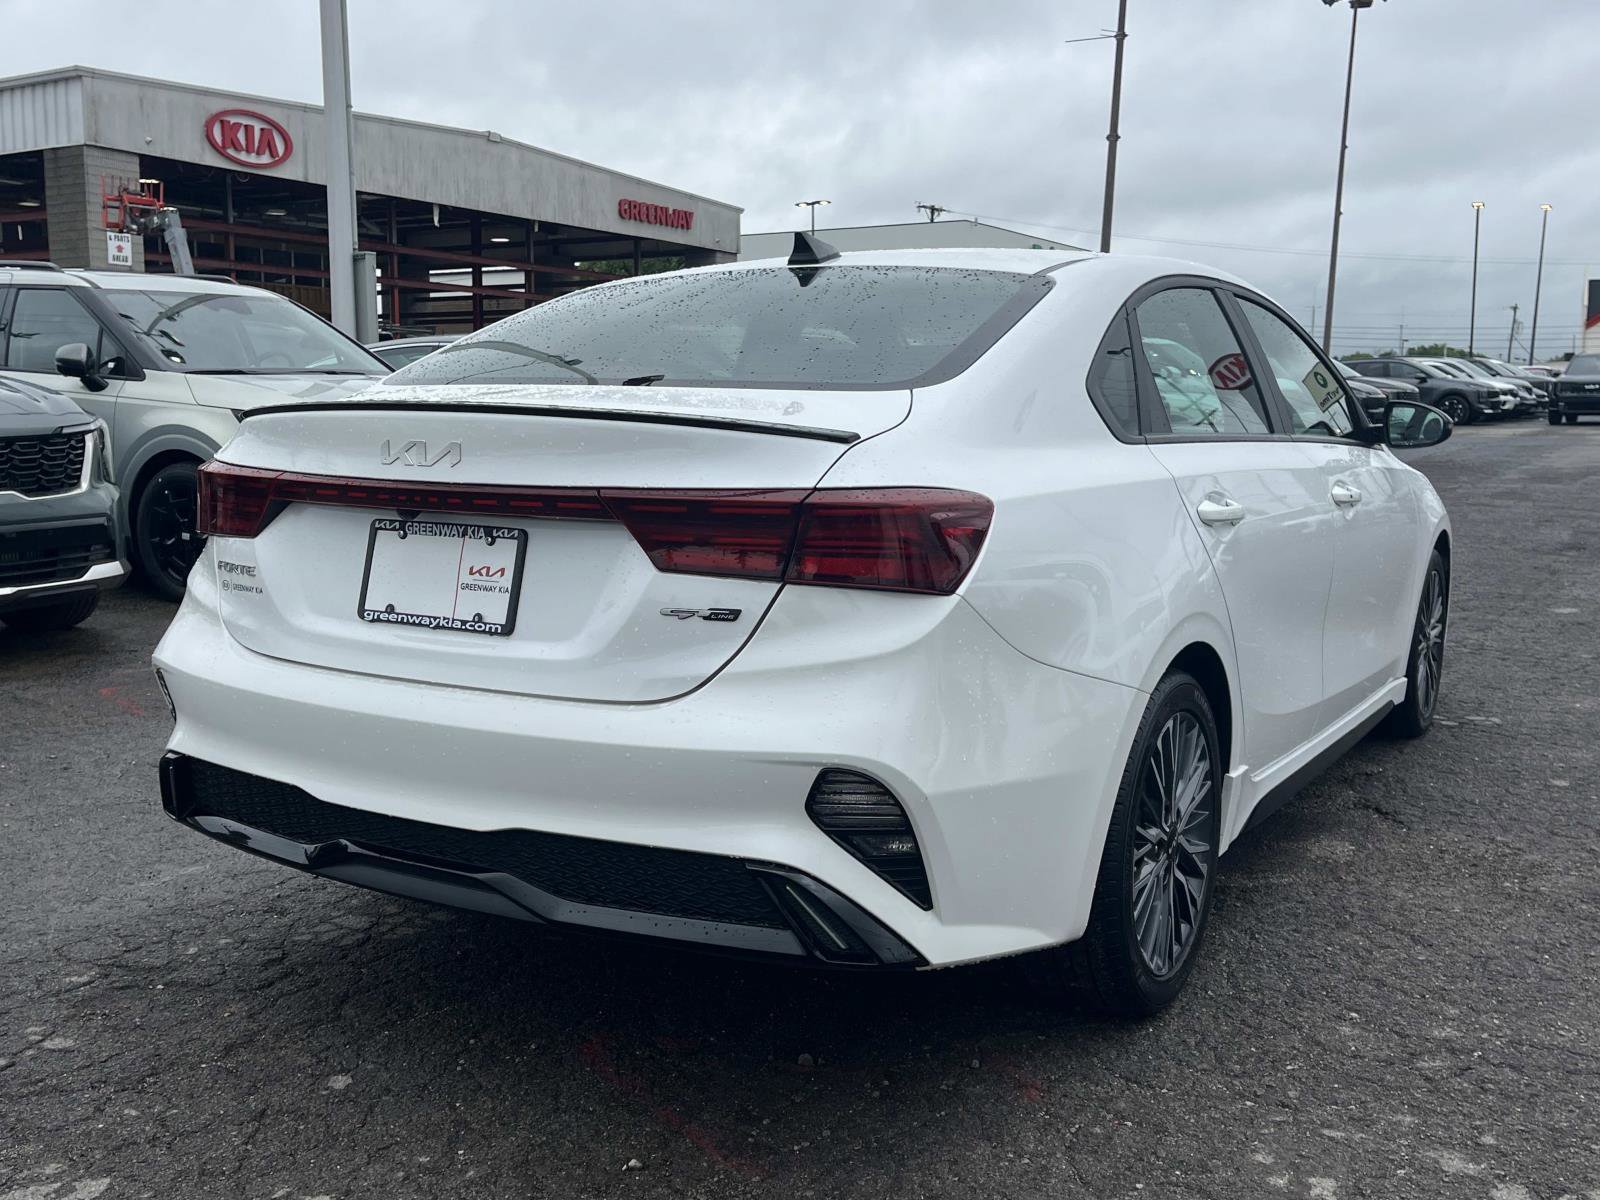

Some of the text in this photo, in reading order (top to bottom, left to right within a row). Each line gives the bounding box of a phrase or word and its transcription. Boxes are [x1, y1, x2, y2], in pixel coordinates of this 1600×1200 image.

[219, 119, 280, 159] KIA
[618, 199, 694, 230] GREENWAY
[380, 439, 462, 468] KIA
[405, 522, 465, 538] GREENWAY
[467, 526, 486, 540] KIA
[217, 560, 257, 577] FORTE
[469, 565, 506, 578] KIA
[460, 582, 510, 594] GREENWAY KIA
[363, 609, 502, 633] greenwaykia.com
